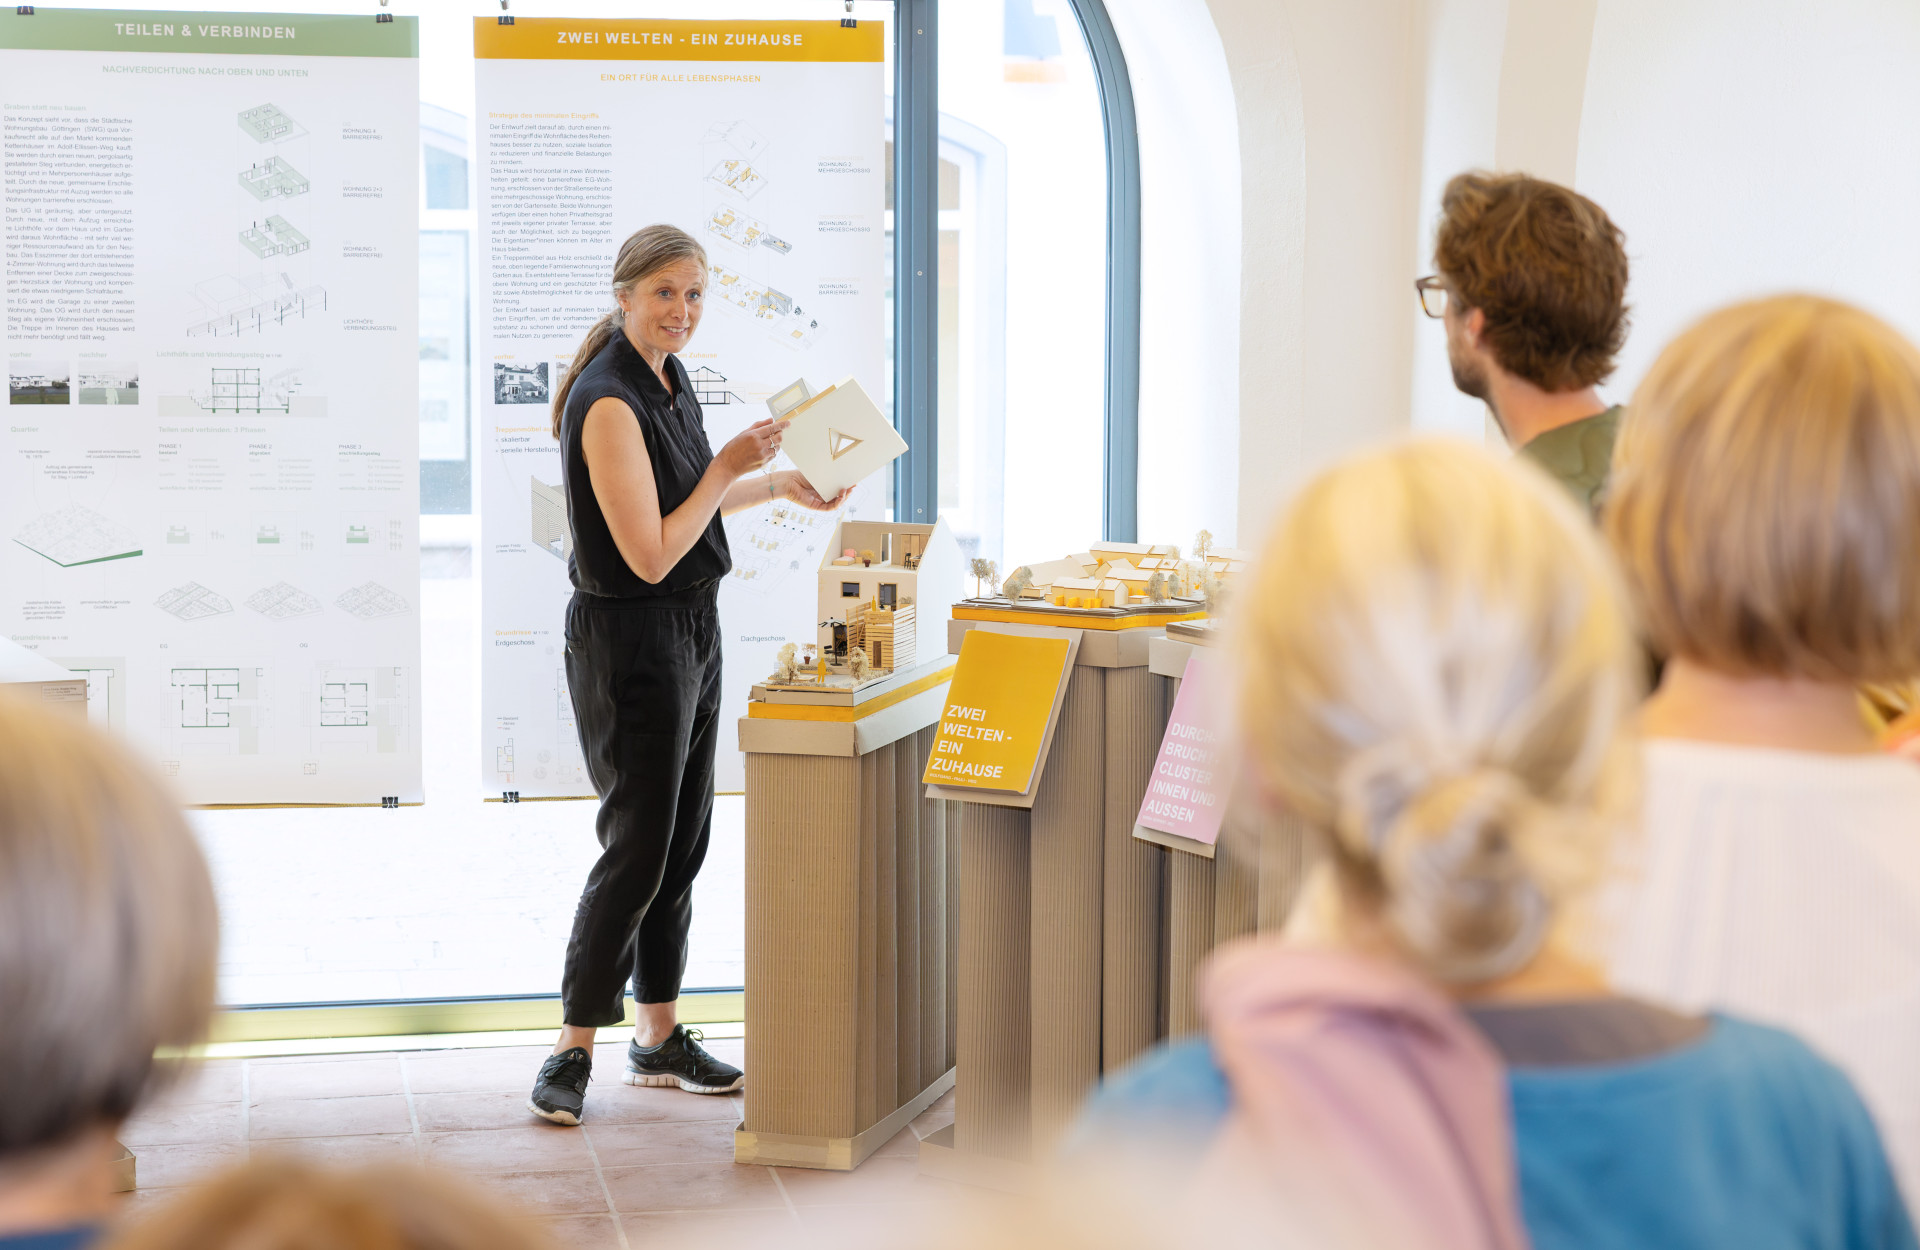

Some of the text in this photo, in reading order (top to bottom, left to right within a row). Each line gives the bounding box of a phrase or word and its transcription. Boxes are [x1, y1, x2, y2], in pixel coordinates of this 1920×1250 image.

[115, 23, 295, 39] TEILEN & VERBINDEN
[557, 32, 599, 44] ZWEI
[606, 33, 672, 44] WELTEN
[691, 34, 718, 45] EIN
[724, 34, 803, 46] ZUHAUSE
[102, 65, 196, 74] NACHVERDICHTUNG
[198, 67, 224, 75] NACH
[227, 68, 252, 76] OBEN
[640, 72, 658, 81] FÜR
[947, 705, 986, 721] ZWEI
[944, 722, 1004, 742] WELTEN
[938, 740, 963, 754] EIN
[932, 757, 1003, 778] ZUHAUSE
[1159, 762, 1213, 785] CLUSTER
[1153, 780, 1216, 807] INNEN UND
[1146, 800, 1194, 823] AUSSEN
